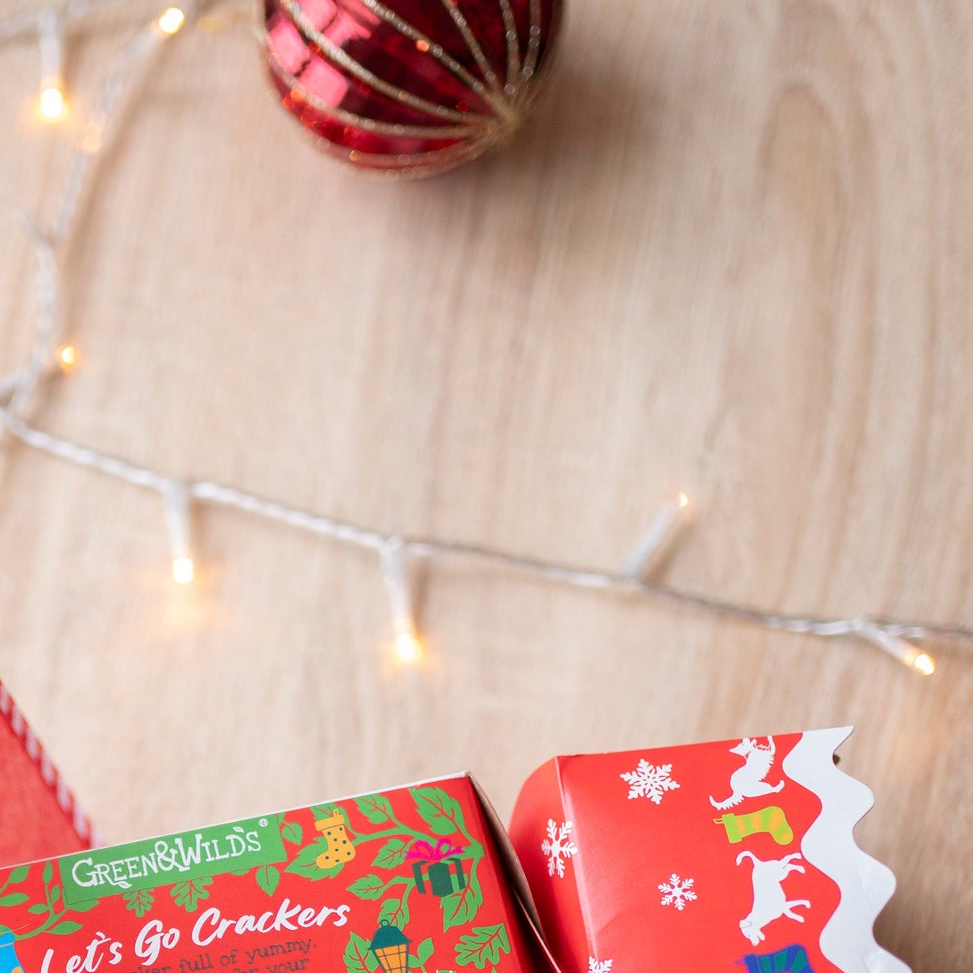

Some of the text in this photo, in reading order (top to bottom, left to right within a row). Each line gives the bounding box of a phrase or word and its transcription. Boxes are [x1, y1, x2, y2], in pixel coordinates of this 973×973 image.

[134, 919, 180, 966] Go
[191, 898, 351, 946] Crackers
[219, 949, 240, 967] of
